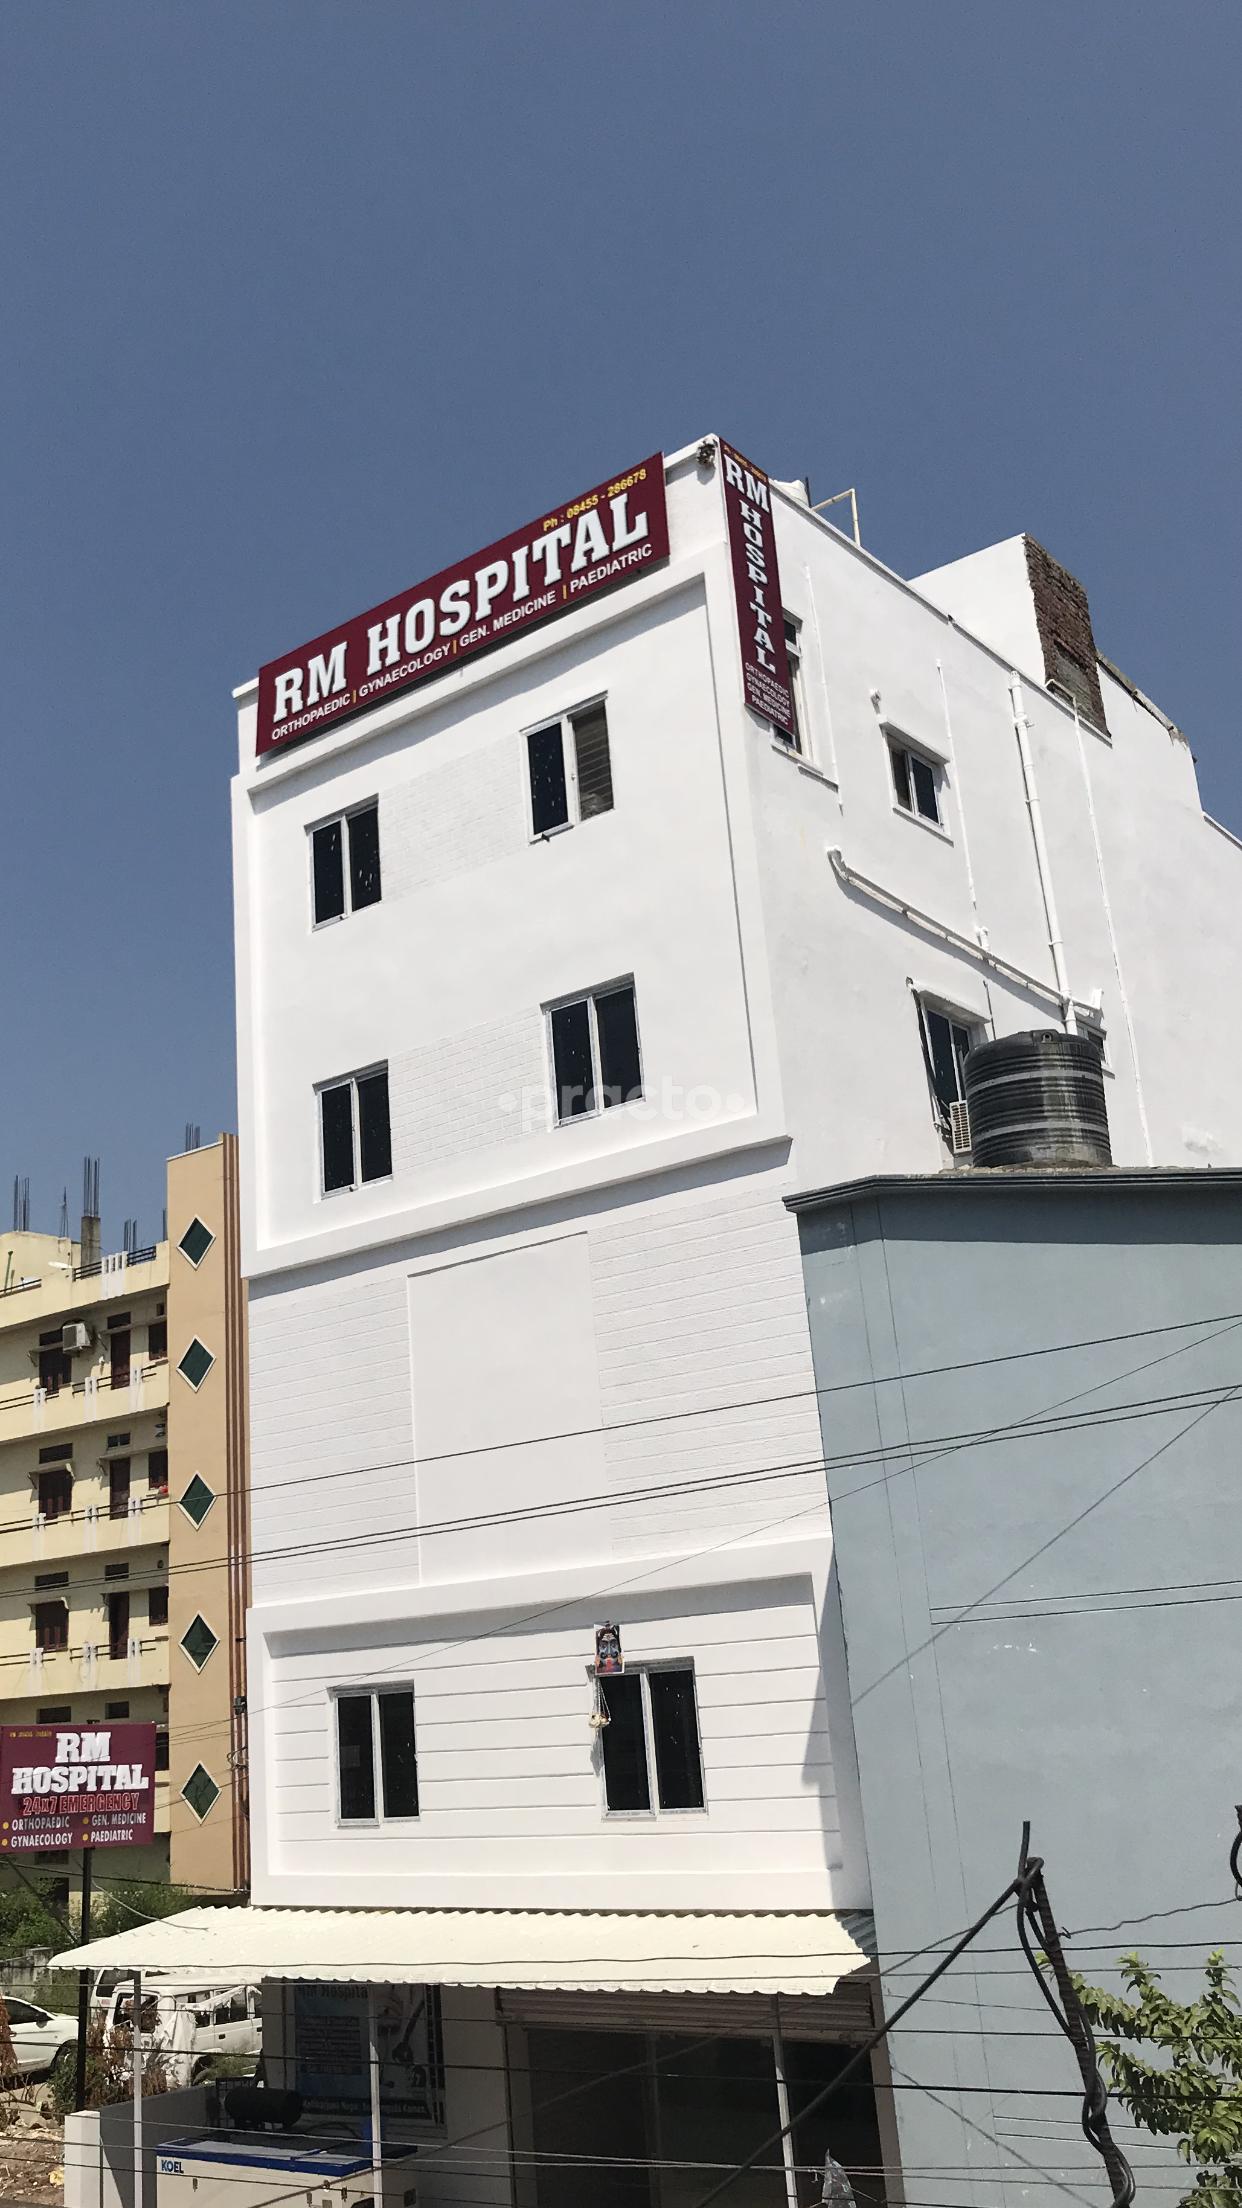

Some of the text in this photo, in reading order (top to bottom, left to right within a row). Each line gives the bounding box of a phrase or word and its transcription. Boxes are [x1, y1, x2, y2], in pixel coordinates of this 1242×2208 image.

[723, 454, 769, 512] RM
[543, 518, 558, 531] Ph
[566, 495, 599, 519] 08455
[739, 500, 776, 674] HOSPITAL
[273, 493, 649, 723] RM HOSPITAL
[272, 543, 653, 740] ORTHOPAEDIC GYNAECOLOGY GEN. MEDICINE PAEDIATRIC
[745, 662, 790, 698] ORTHOPAEDIC
[55, 1731, 112, 1763] RM
[11, 1764, 149, 1794] HOSPITAL
[60, 1792, 140, 1814] EMERGENCY
[12, 1816, 70, 1831] ORTHOPAEDIC
[91, 1812, 147, 1826] GEN. MEDICINE
[11, 1832, 73, 1848] GYNAECOLOGY
[90, 1829, 134, 1843] PAEDIATRIC
[321, 1984, 369, 2001] Hospita
[161, 2159, 184, 2174] KOEL
